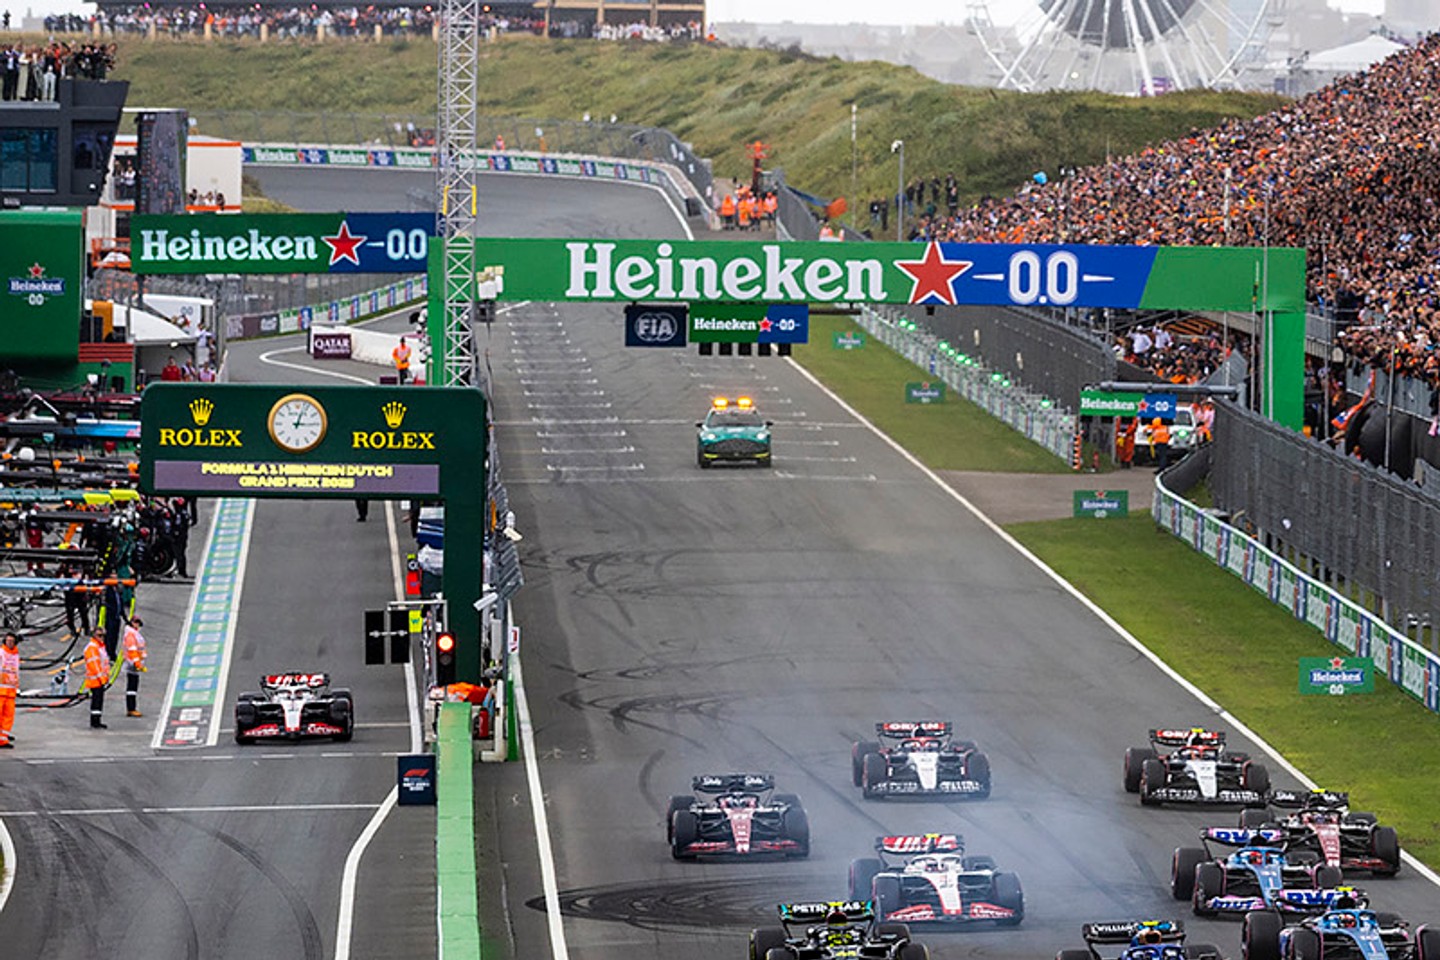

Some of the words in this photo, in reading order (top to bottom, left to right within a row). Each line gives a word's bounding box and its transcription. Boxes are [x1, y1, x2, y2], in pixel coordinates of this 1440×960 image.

[140, 229, 318, 261] Heineken
[387, 229, 427, 260] 0.0
[565, 242, 888, 301] Heineken
[1008, 250, 1079, 305] 0.0
[638, 317, 673, 336] FIA
[693, 317, 757, 331] Heineken
[1081, 397, 1136, 410] Heineken
[159, 428, 243, 447] ROLEX
[352, 431, 436, 450] ROLEX
[346, 465, 392, 477] DUTCH
[1312, 671, 1361, 682] Heineken
[791, 901, 861, 914] PETRAS
